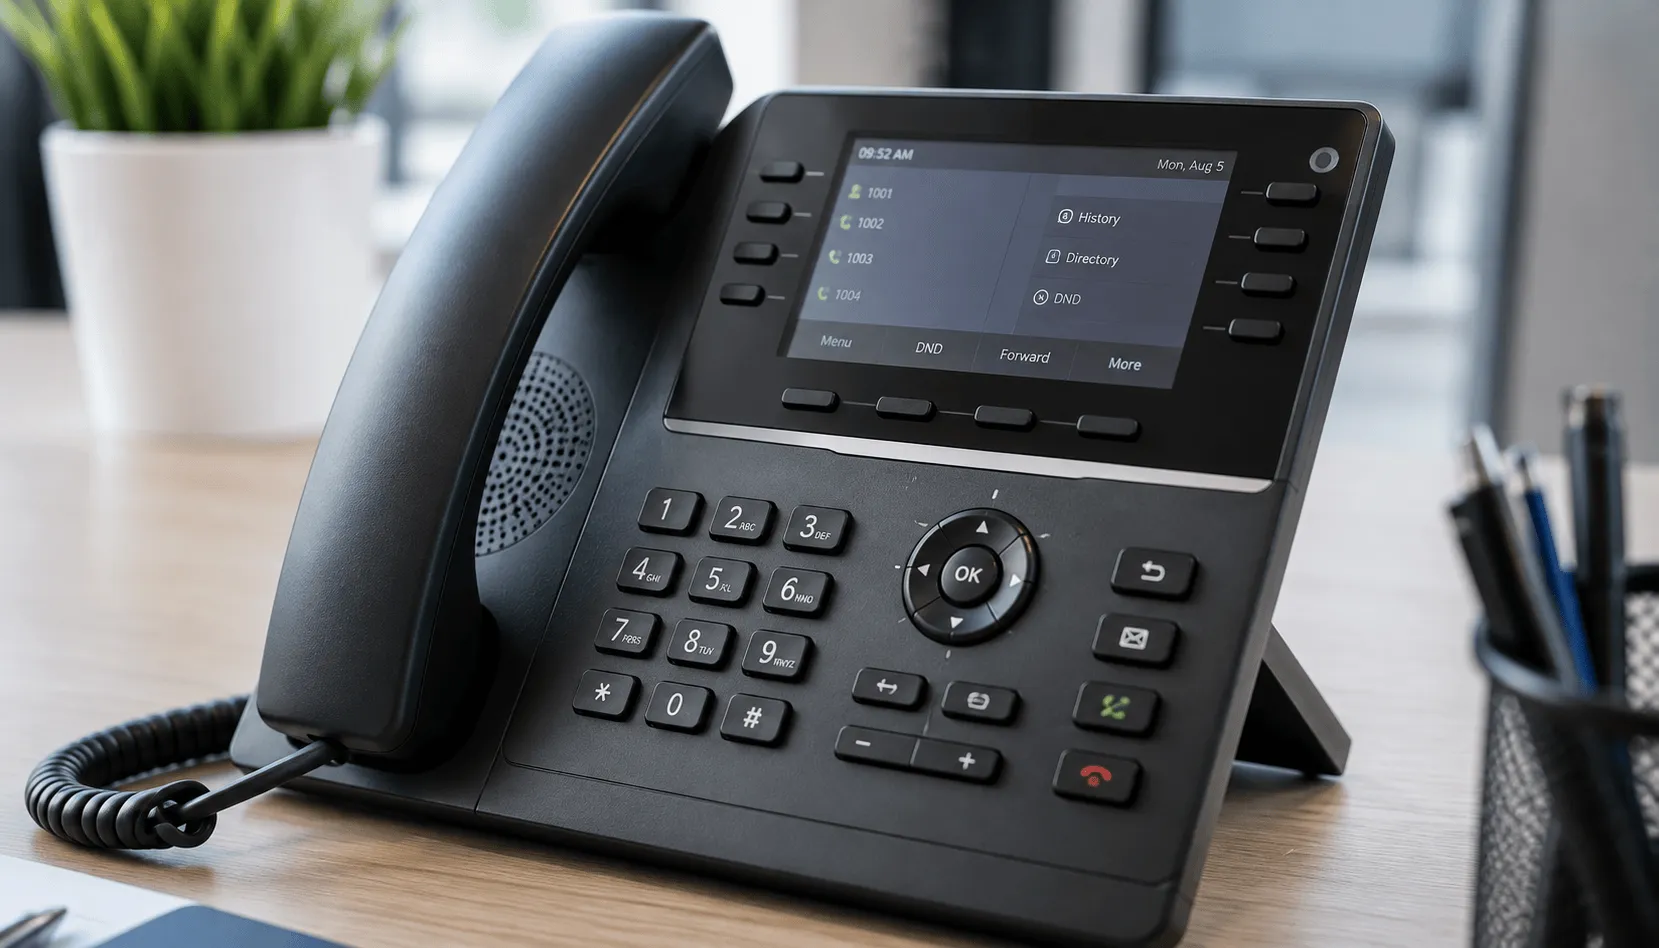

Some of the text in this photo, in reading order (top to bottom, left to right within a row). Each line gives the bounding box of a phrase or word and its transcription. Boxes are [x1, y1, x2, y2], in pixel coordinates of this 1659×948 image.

[859, 147, 913, 160] 09:52 AM
[1158, 159, 1224, 173] Mon, Aug 5
[869, 188, 892, 198] 1001
[859, 217, 884, 229] 1002
[1079, 213, 1120, 227] History
[848, 253, 873, 264] 1003
[1066, 253, 1119, 267] Directory
[836, 290, 861, 300] 1004
[1054, 293, 1081, 304] DND
[821, 335, 852, 347] Menu
[916, 342, 942, 354] DND
[1000, 349, 1050, 363] Forward
[1109, 358, 1141, 370] More
[662, 498, 671, 520] 1
[725, 505, 743, 529] 2
[800, 515, 817, 538] 3
[632, 557, 650, 580] 4
[955, 566, 982, 583] OK
[705, 567, 723, 591] 5
[780, 577, 798, 601] 6
[611, 617, 629, 642] 7
[684, 629, 701, 653] 8
[759, 640, 776, 665] 9
[667, 693, 682, 715] 0
[744, 707, 762, 728] #
